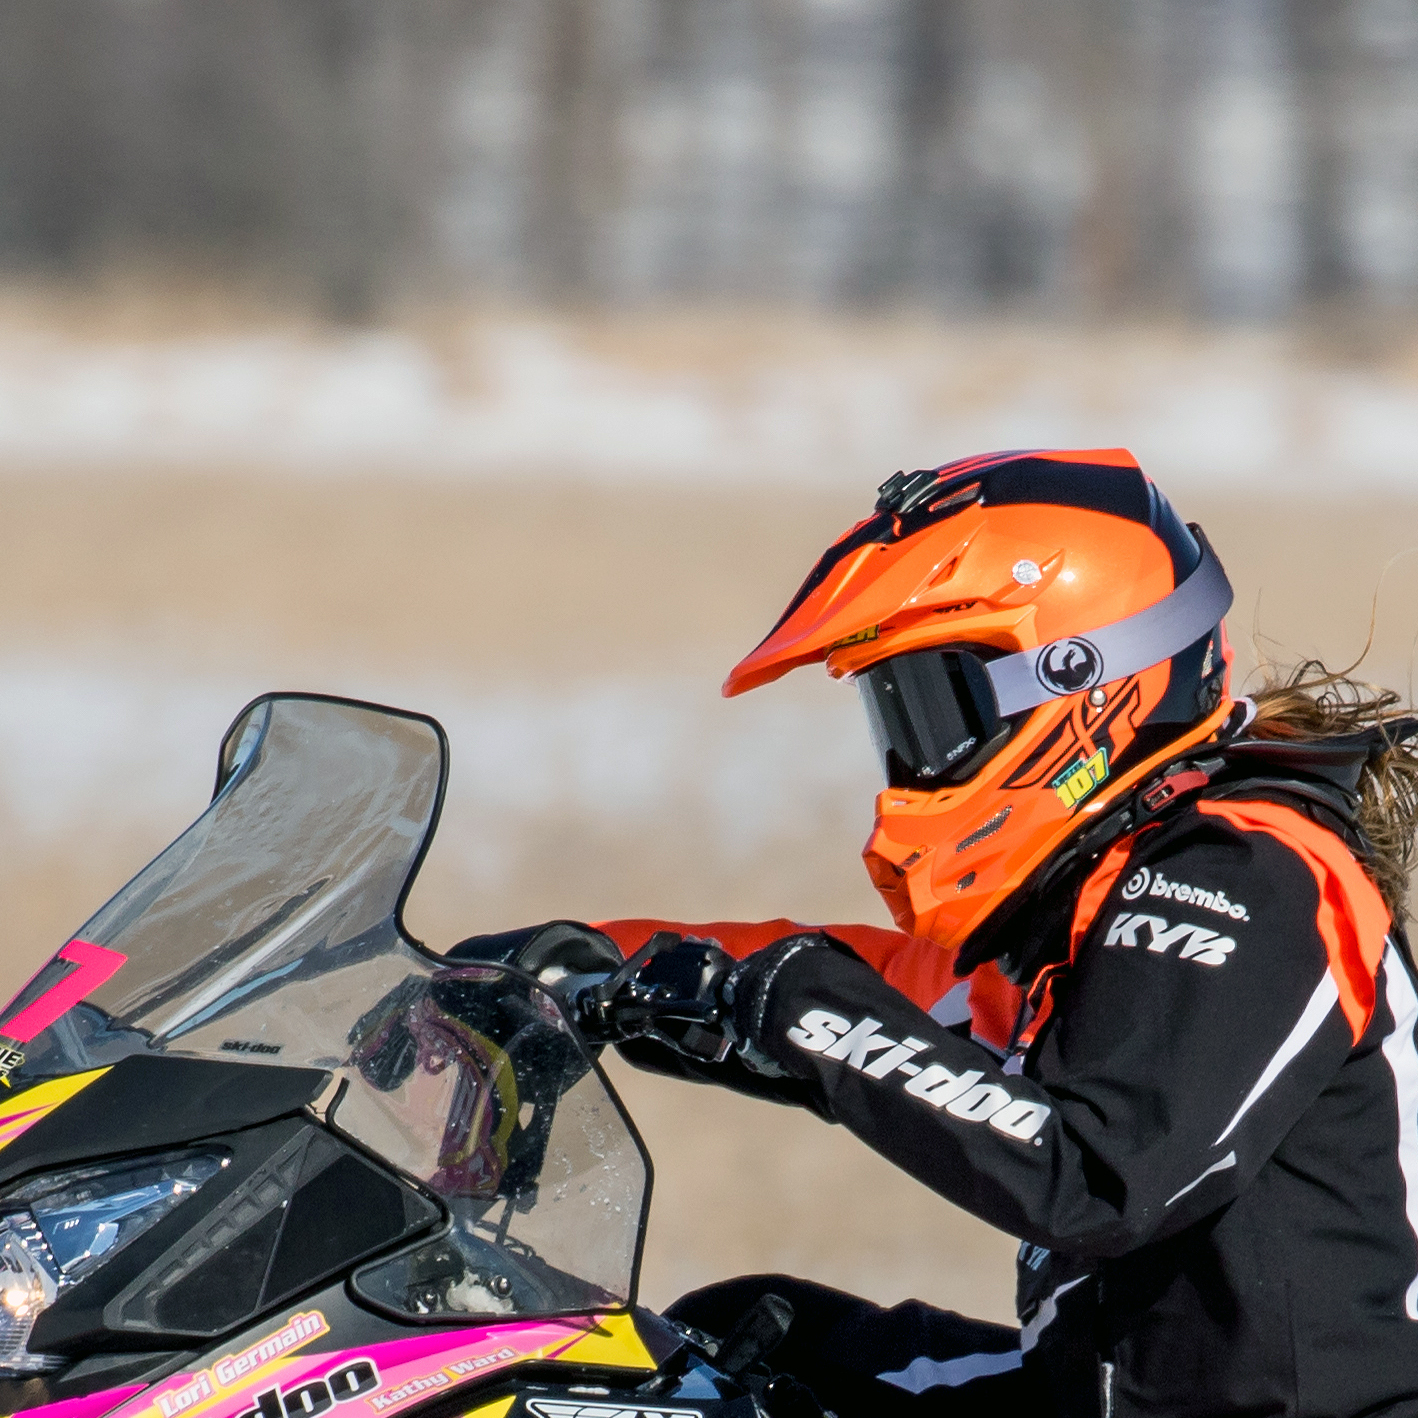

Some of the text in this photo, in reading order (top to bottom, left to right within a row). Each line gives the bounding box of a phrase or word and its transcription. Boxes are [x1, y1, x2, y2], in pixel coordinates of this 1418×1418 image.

[1056, 750, 1107, 808] 107
[1104, 914, 1237, 965] KYB
[221, 1041, 281, 1054] ski-doo
[158, 1314, 324, 1418] Lori Germain
[372, 1348, 515, 1411] Kathy Ward
